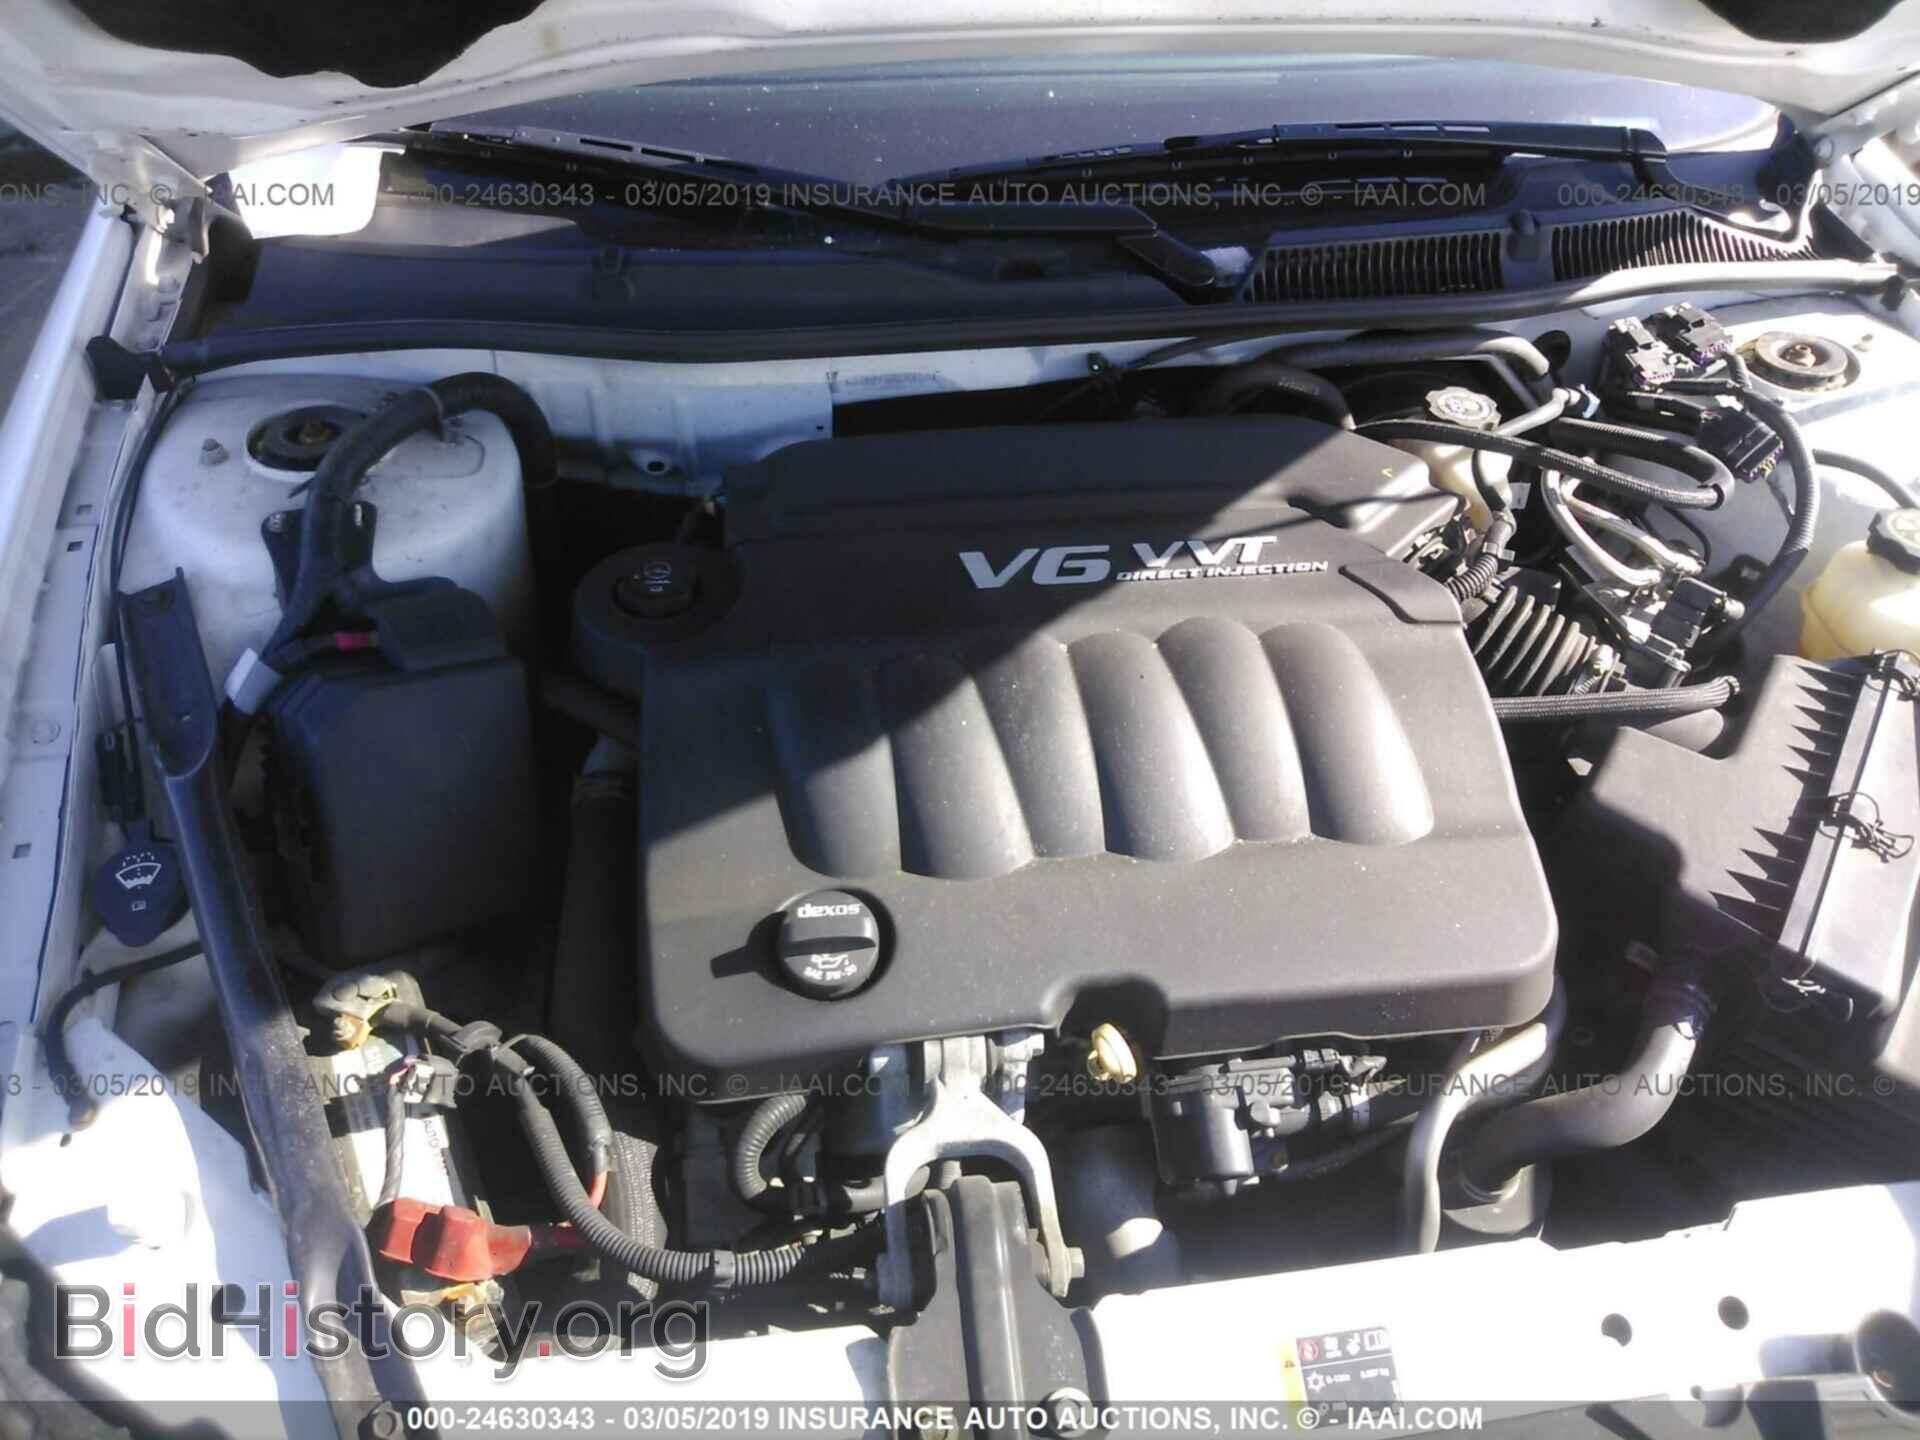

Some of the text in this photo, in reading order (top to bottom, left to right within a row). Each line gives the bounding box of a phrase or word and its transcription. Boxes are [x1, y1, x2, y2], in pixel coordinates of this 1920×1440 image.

[958, 535, 1278, 589] V6 VVT
[1116, 561, 1329, 582] DIRECT INJECTION
[797, 903, 861, 918] dexos
